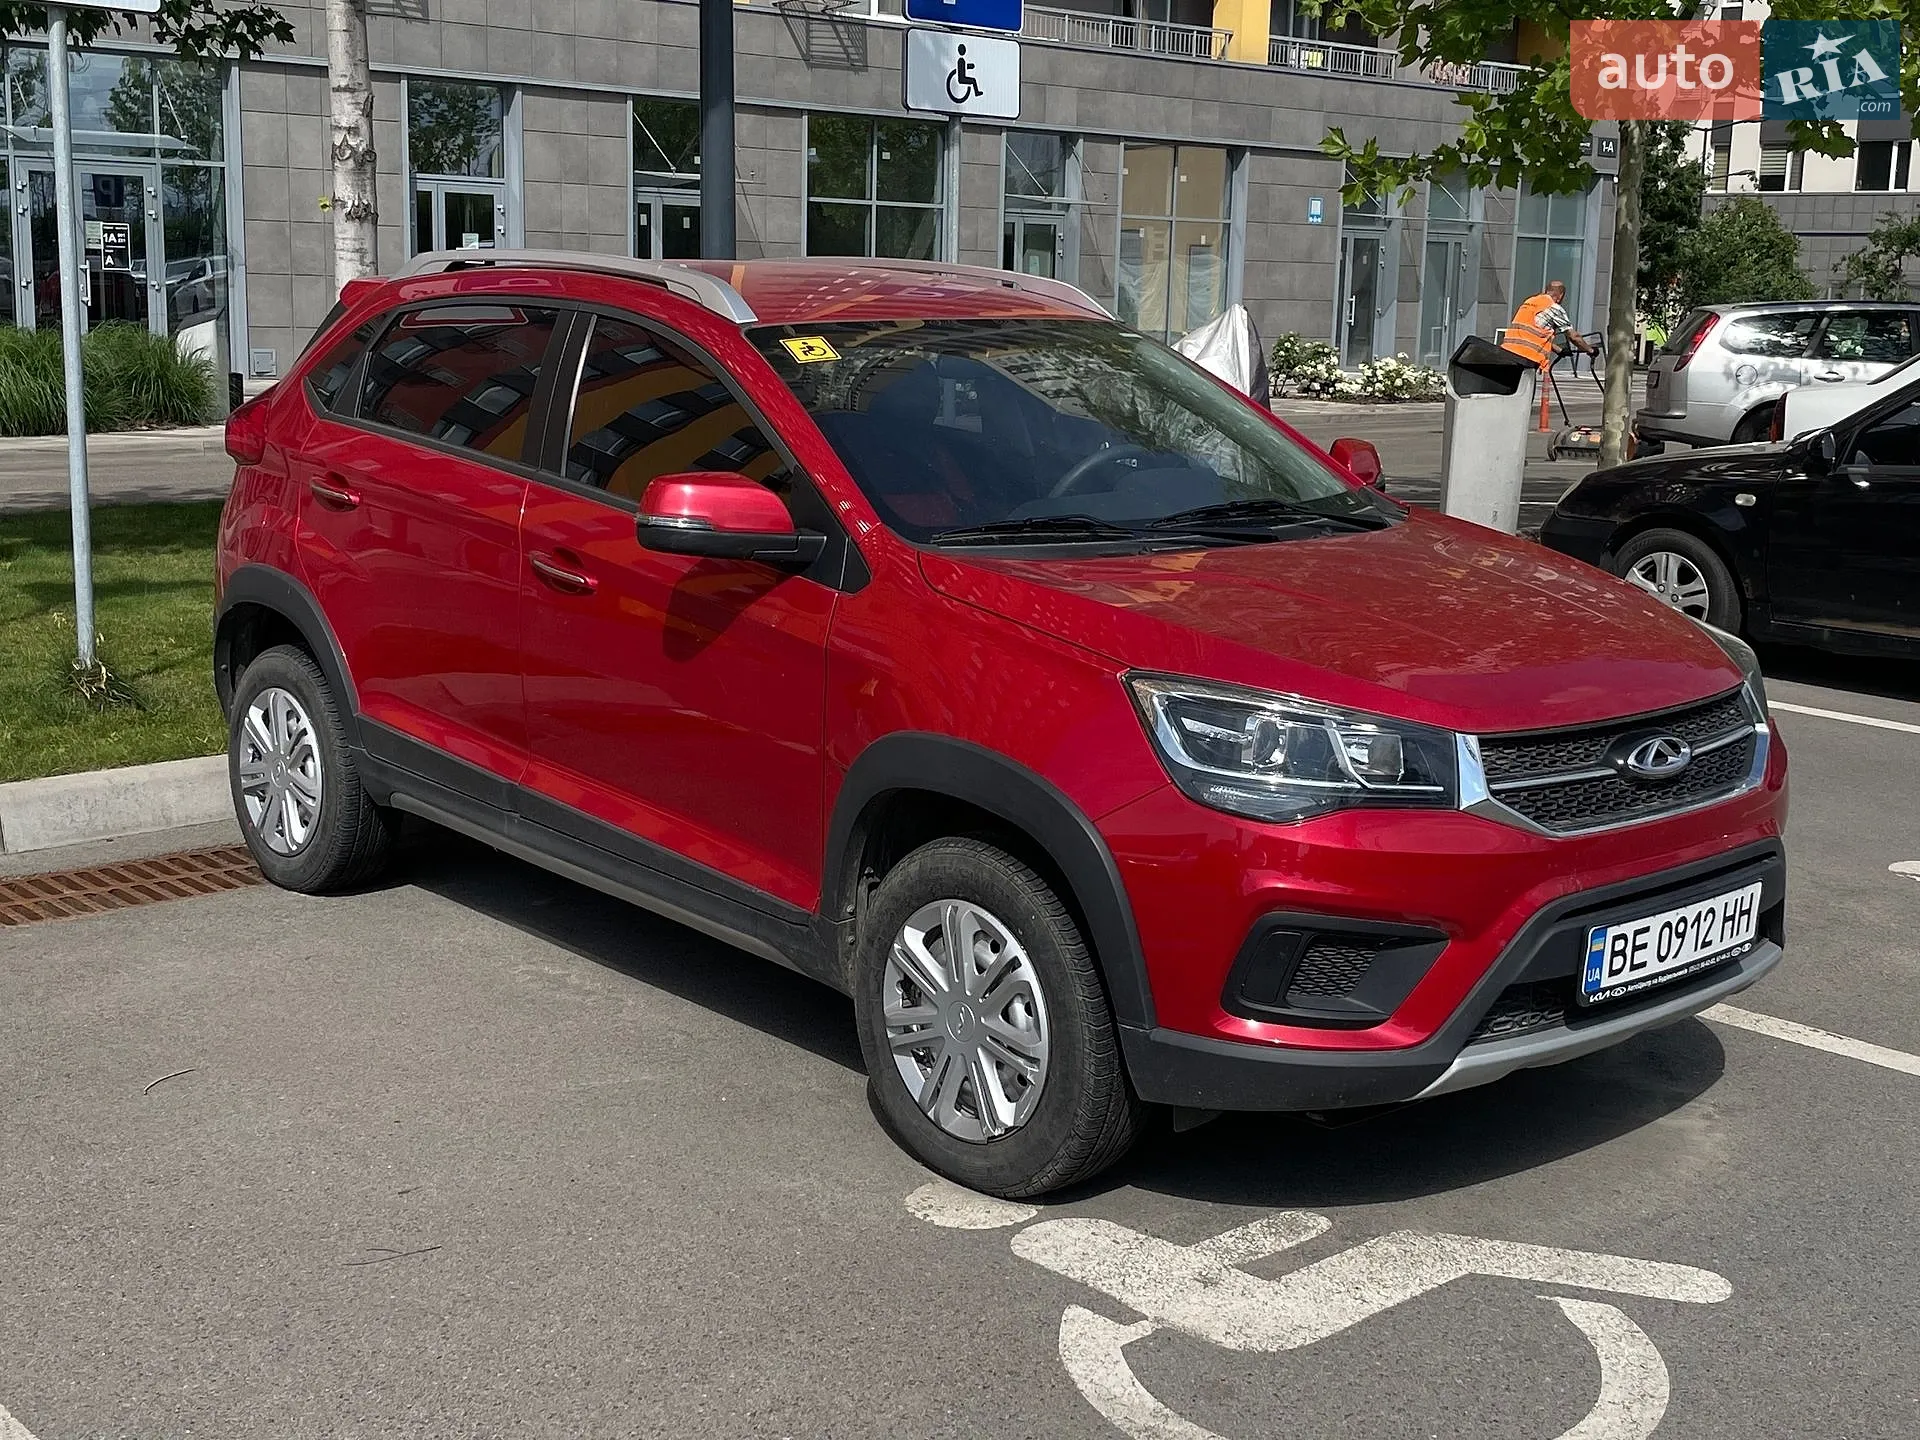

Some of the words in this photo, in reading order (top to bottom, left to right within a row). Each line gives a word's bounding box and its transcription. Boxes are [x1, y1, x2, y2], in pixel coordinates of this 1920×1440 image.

[1608, 926, 1651, 977] BE
[1656, 907, 1716, 963] 0912
[1720, 892, 1754, 943] HH
[1587, 967, 1600, 982] UA
